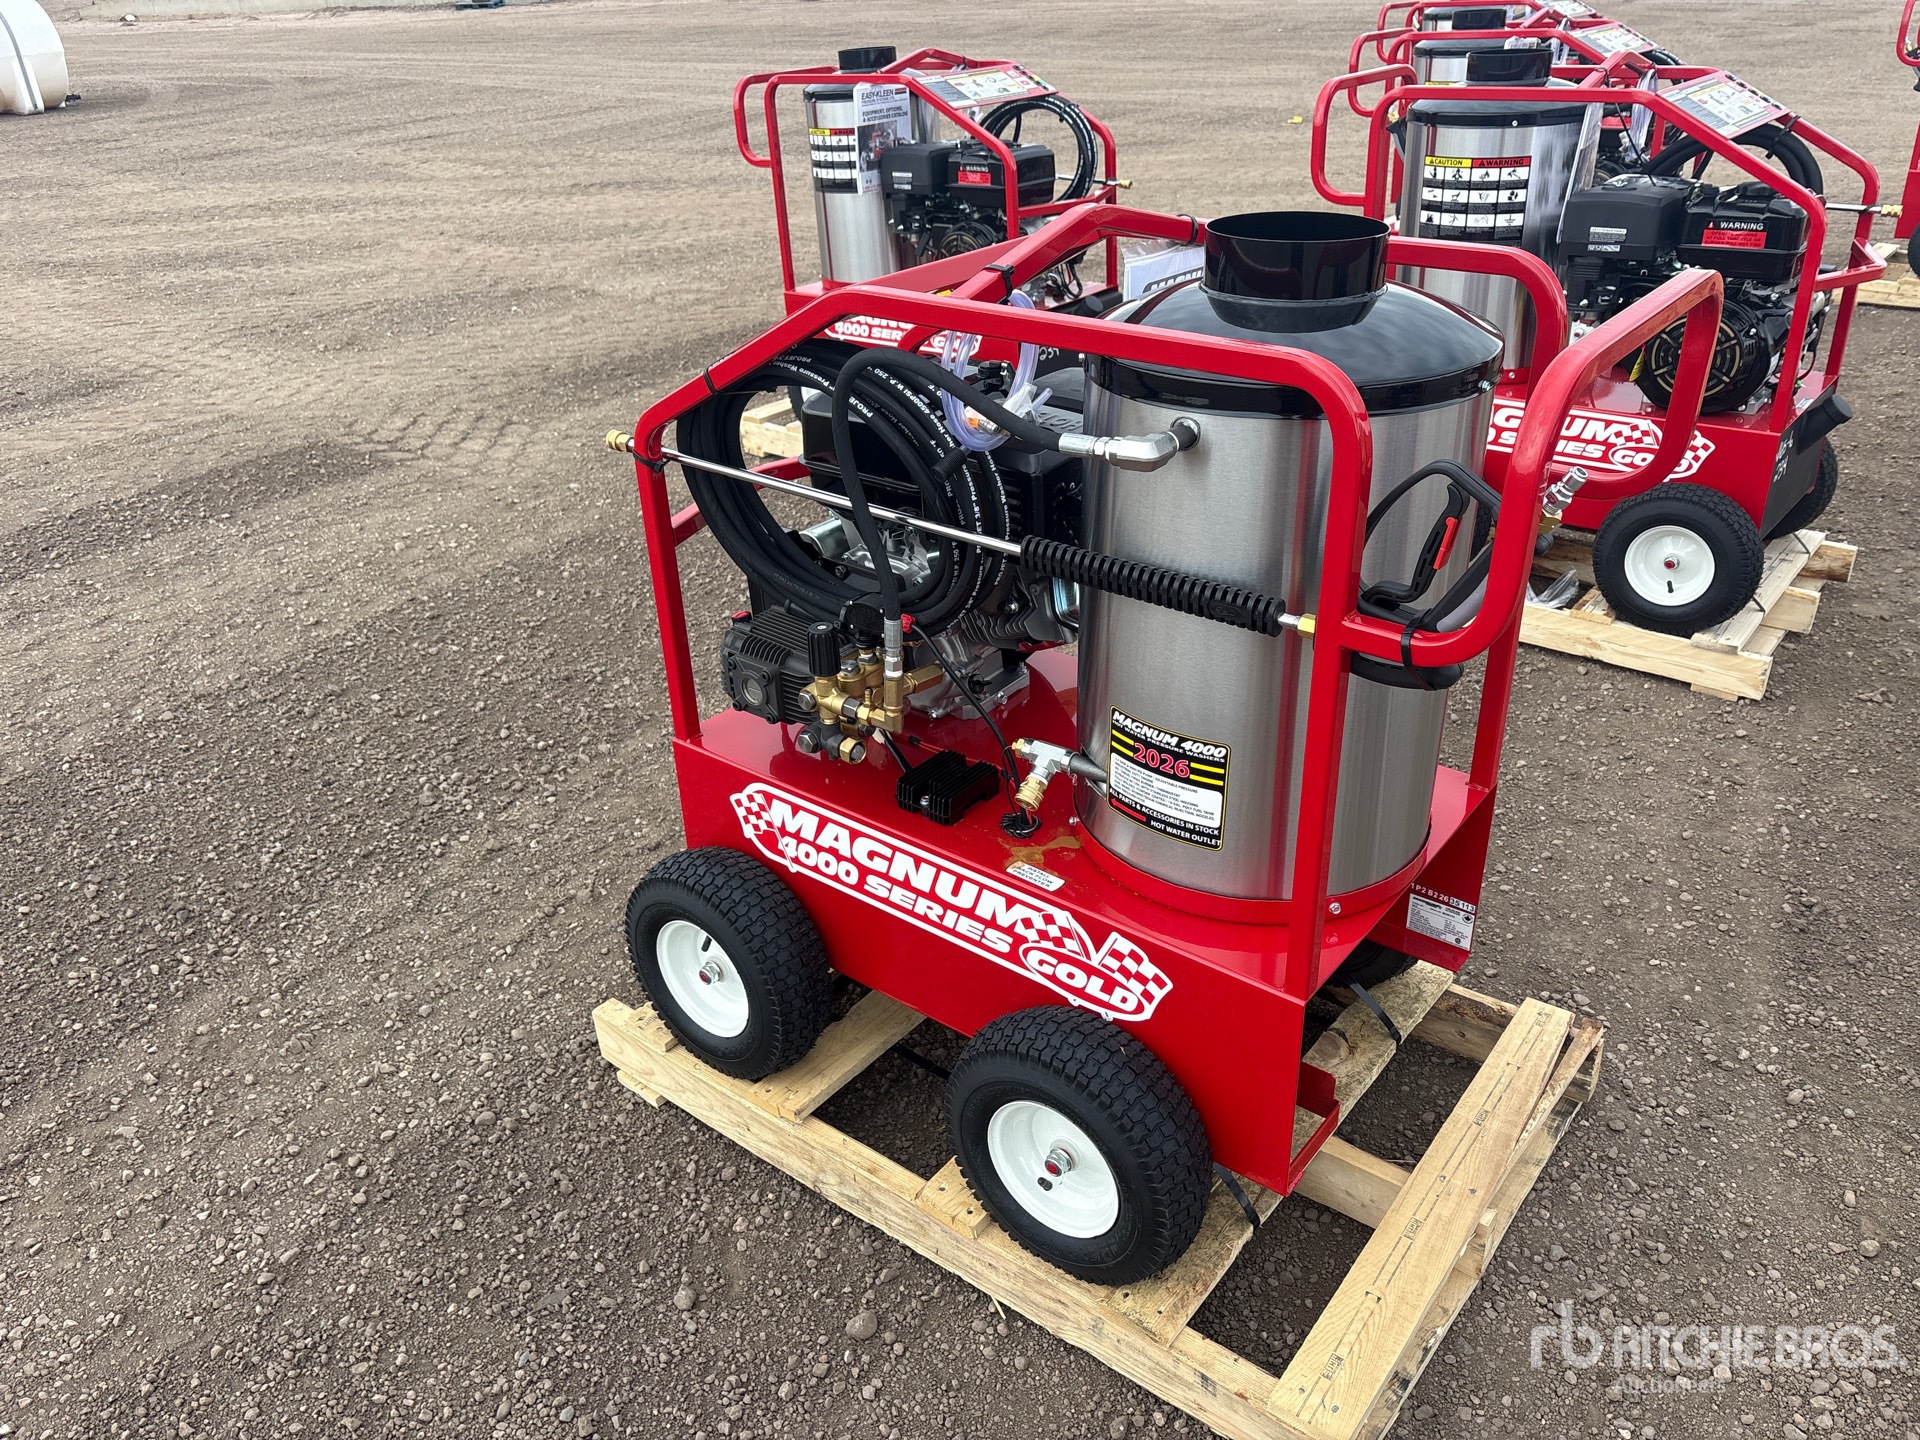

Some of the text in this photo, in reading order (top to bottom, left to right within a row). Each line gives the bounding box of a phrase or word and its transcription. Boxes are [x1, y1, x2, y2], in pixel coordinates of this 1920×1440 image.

[861, 88, 894, 100] EASY-KLEEN
[1720, 221, 1764, 230] WARNING
[834, 322, 869, 336] 4000
[772, 361, 830, 387] Pressure Washer
[874, 368, 889, 379] 250
[890, 376, 904, 391] W.P.
[849, 396, 873, 418] PROJE
[903, 388, 930, 414] 4500PSI
[930, 414, 946, 434] Hose
[1498, 430, 1606, 458] SIES
[985, 450, 996, 472] Hose
[1614, 450, 1689, 472] GOD
[962, 463, 977, 501] Pressure
[994, 472, 1006, 503] Washer
[972, 566, 983, 596] Pressure
[994, 558, 1007, 585] PROJET
[1112, 711, 1227, 758] MAGNUM 4000
[1112, 720, 1225, 763] HOT WATER PRESSURE WASHERS
[1134, 742, 1190, 778] 2026
[1110, 788, 1119, 798] ALL
[1119, 794, 1136, 808] PARTS
[1142, 806, 1185, 827] ACCESSORIES
[1186, 822, 1193, 830] IN
[1195, 825, 1219, 836] STOCK
[1150, 820, 1221, 846] HOT WATER OUTLET
[770, 798, 1037, 938] MAGNUM
[1013, 870, 1050, 887] PREVENTER
[1027, 867, 1050, 878] INSTALL
[1034, 874, 1054, 884] FLOW
[778, 834, 1013, 954] 4000 SERIES
[1026, 949, 1139, 1012] GOLD
